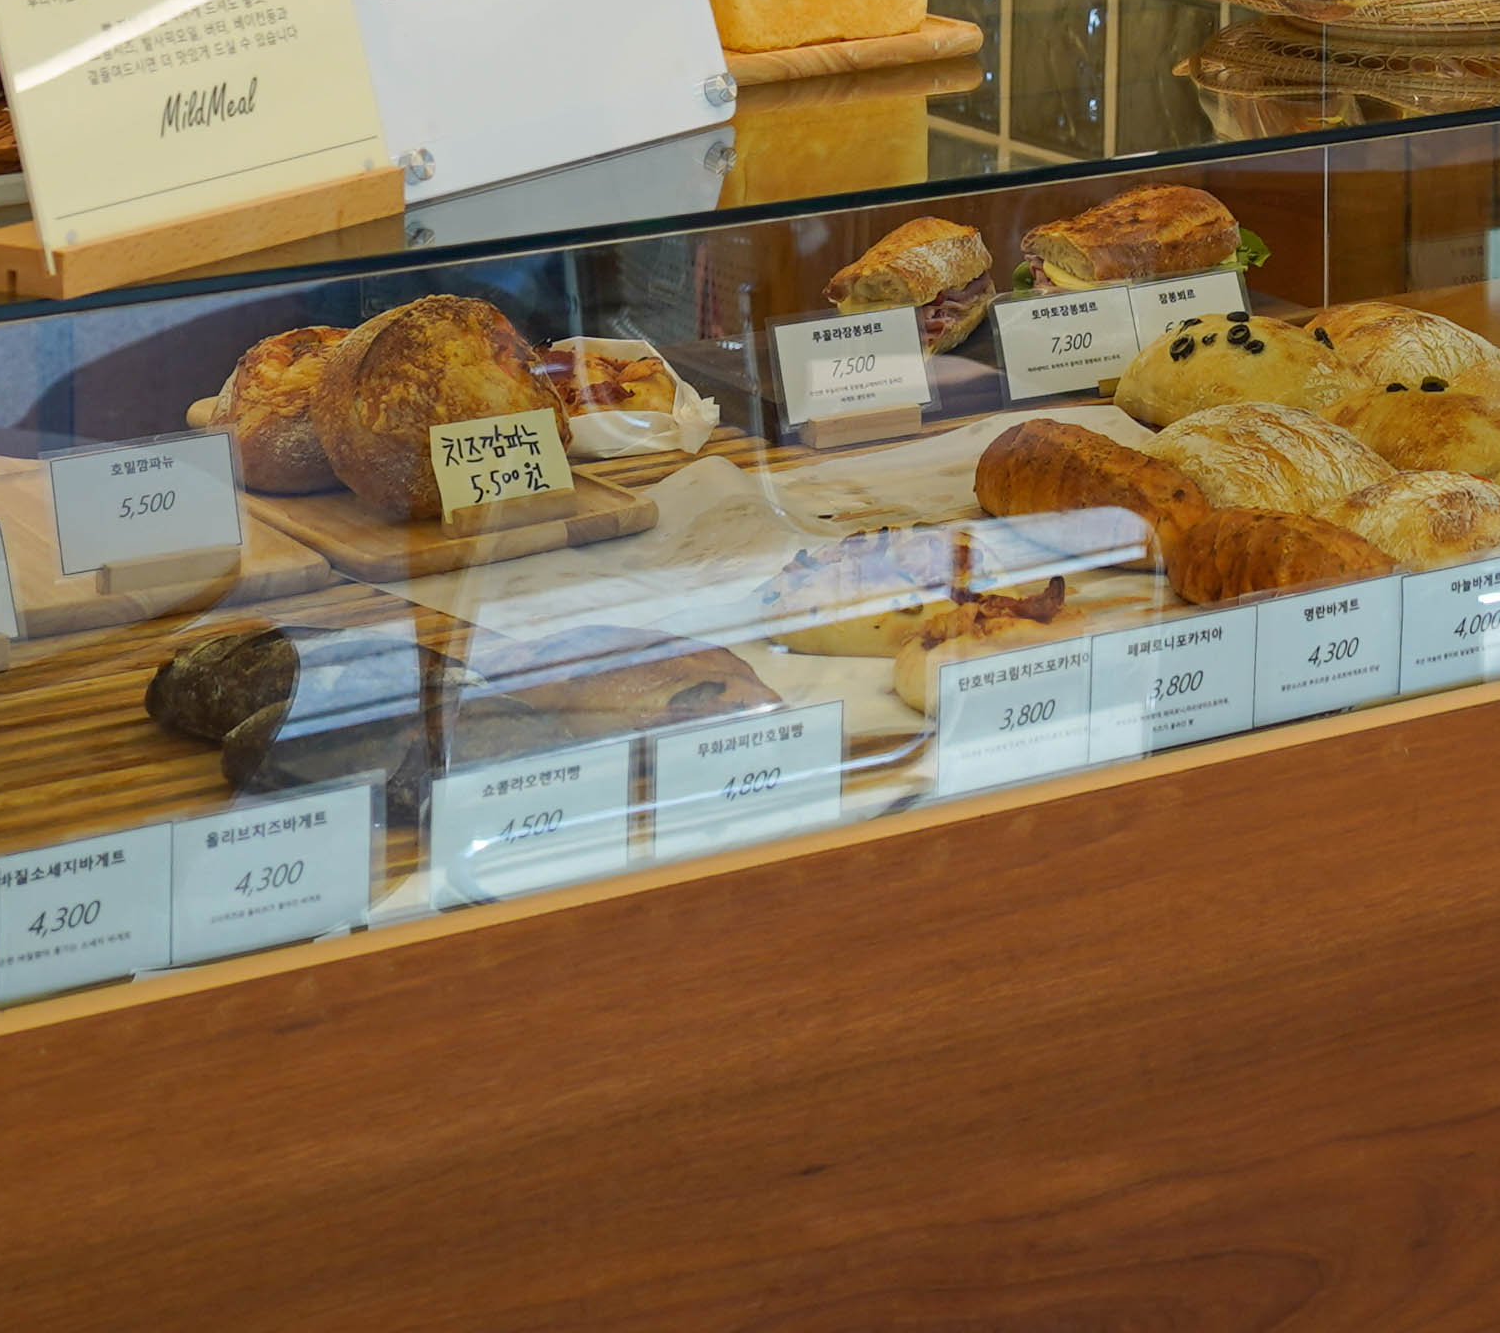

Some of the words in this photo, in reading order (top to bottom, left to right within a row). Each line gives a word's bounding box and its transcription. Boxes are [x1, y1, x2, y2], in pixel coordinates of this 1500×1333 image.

[160, 76, 258, 138] MildMeal
[811, 322, 883, 343] 루꼴라장봉뵈르
[1031, 300, 1098, 320] 토마토장봉뵈르
[1158, 288, 1196, 305] 장봉뵈르
[831, 353, 876, 378] 7,500
[1051, 331, 1093, 355] 7,300
[111, 454, 174, 476] 호밀깜파뉴
[441, 424, 542, 467] 치즈깜파뉴
[119, 490, 176, 520] 5,500
[1303, 598, 1361, 622] 명란바게트
[1127, 626, 1223, 657] 페퍼로니포카치아
[1307, 636, 1360, 668] 4,300
[998, 699, 1056, 732] 3,800
[1149, 669, 1204, 701] 3,800
[481, 765, 581, 798] 쇼콜라오렌지빵
[698, 722, 805, 758] 무화과피칸호밀빵
[500, 808, 564, 844] 4,500
[723, 767, 781, 802] 4,800
[0, 849, 126, 887] 바질소세지바게트
[205, 810, 327, 850] 올리브치즈바게트
[28, 899, 102, 937] 4,300
[234, 860, 305, 898] 4,300
